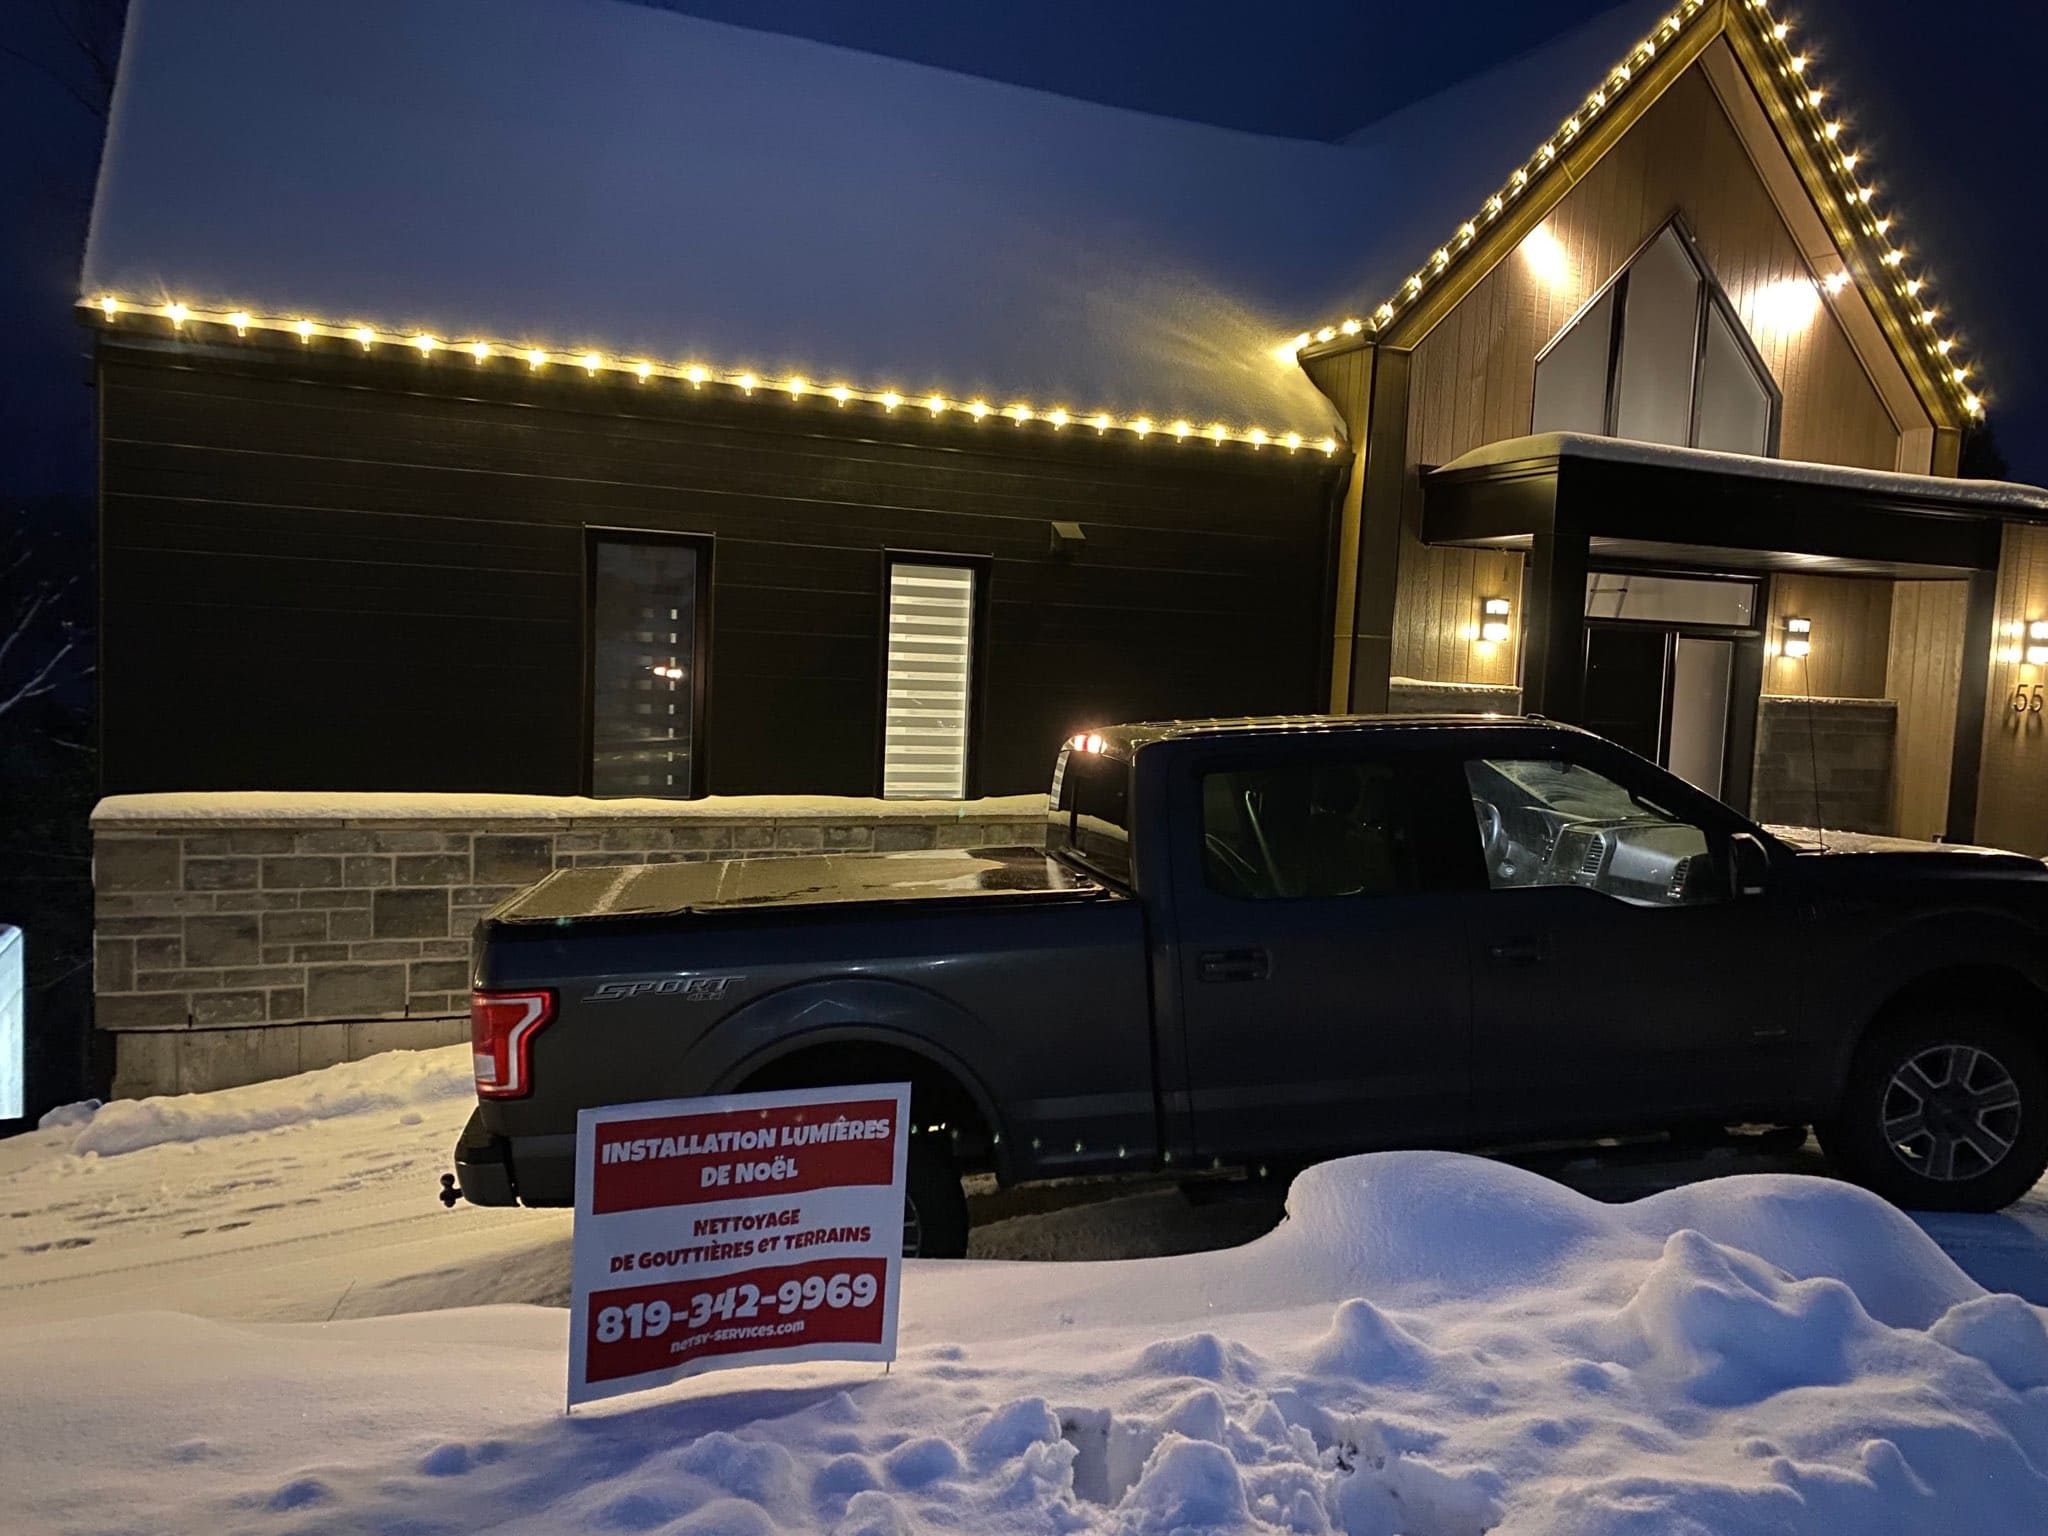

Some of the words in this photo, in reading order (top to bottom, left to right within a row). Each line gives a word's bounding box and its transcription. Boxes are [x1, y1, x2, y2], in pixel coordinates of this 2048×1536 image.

[2014, 684, 2043, 713] 55
[582, 975, 747, 1002] SPORT
[602, 1128, 776, 1164] INSTALLATION
[701, 1166, 730, 1188] DE
[693, 1208, 800, 1237] NETTOYAGE
[610, 1254, 634, 1273] DE
[638, 1239, 753, 1268] GOUTTIÈRES
[784, 1226, 871, 1250] TERRAINS
[596, 1273, 877, 1343] 819-342-9969
